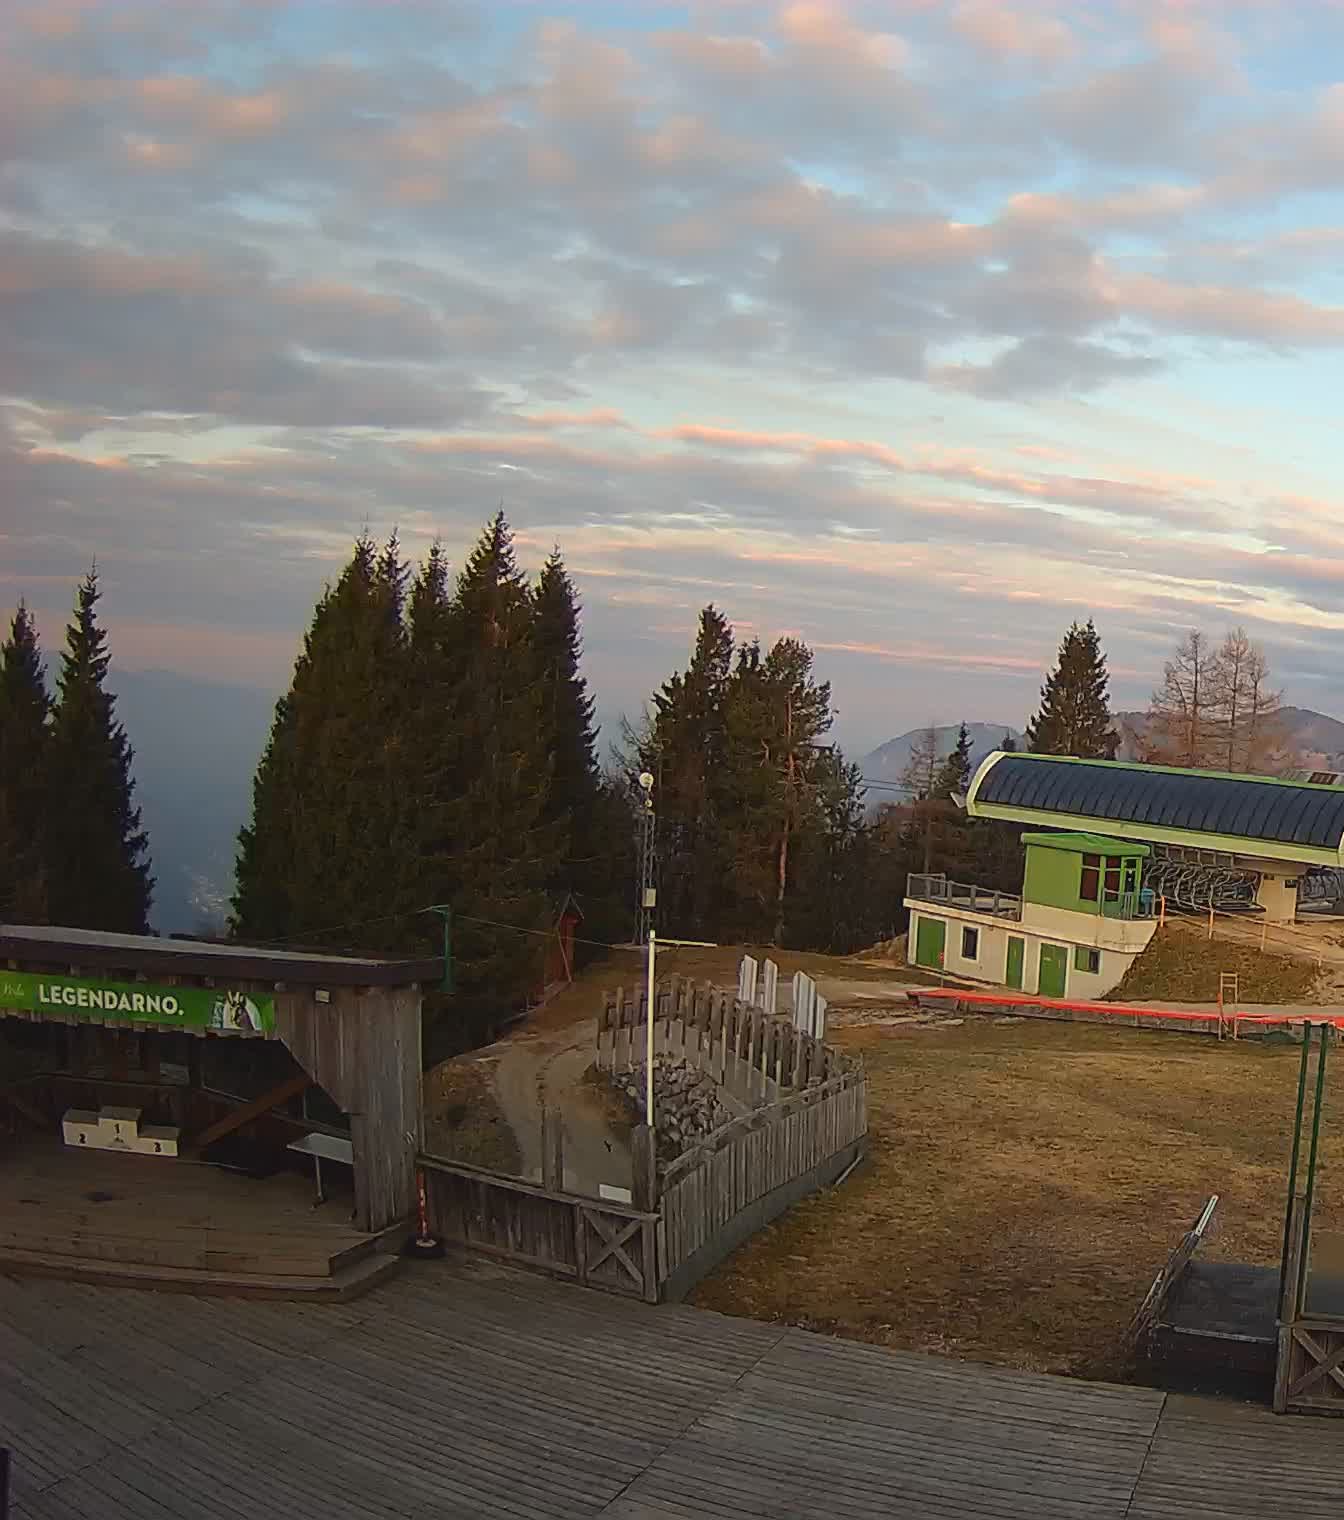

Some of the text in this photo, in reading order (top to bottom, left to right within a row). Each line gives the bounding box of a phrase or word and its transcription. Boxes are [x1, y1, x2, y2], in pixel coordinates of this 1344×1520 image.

[39, 984, 184, 1015] LEGENDARNO.
[113, 1122, 120, 1134] 1
[79, 1132, 86, 1144] 2
